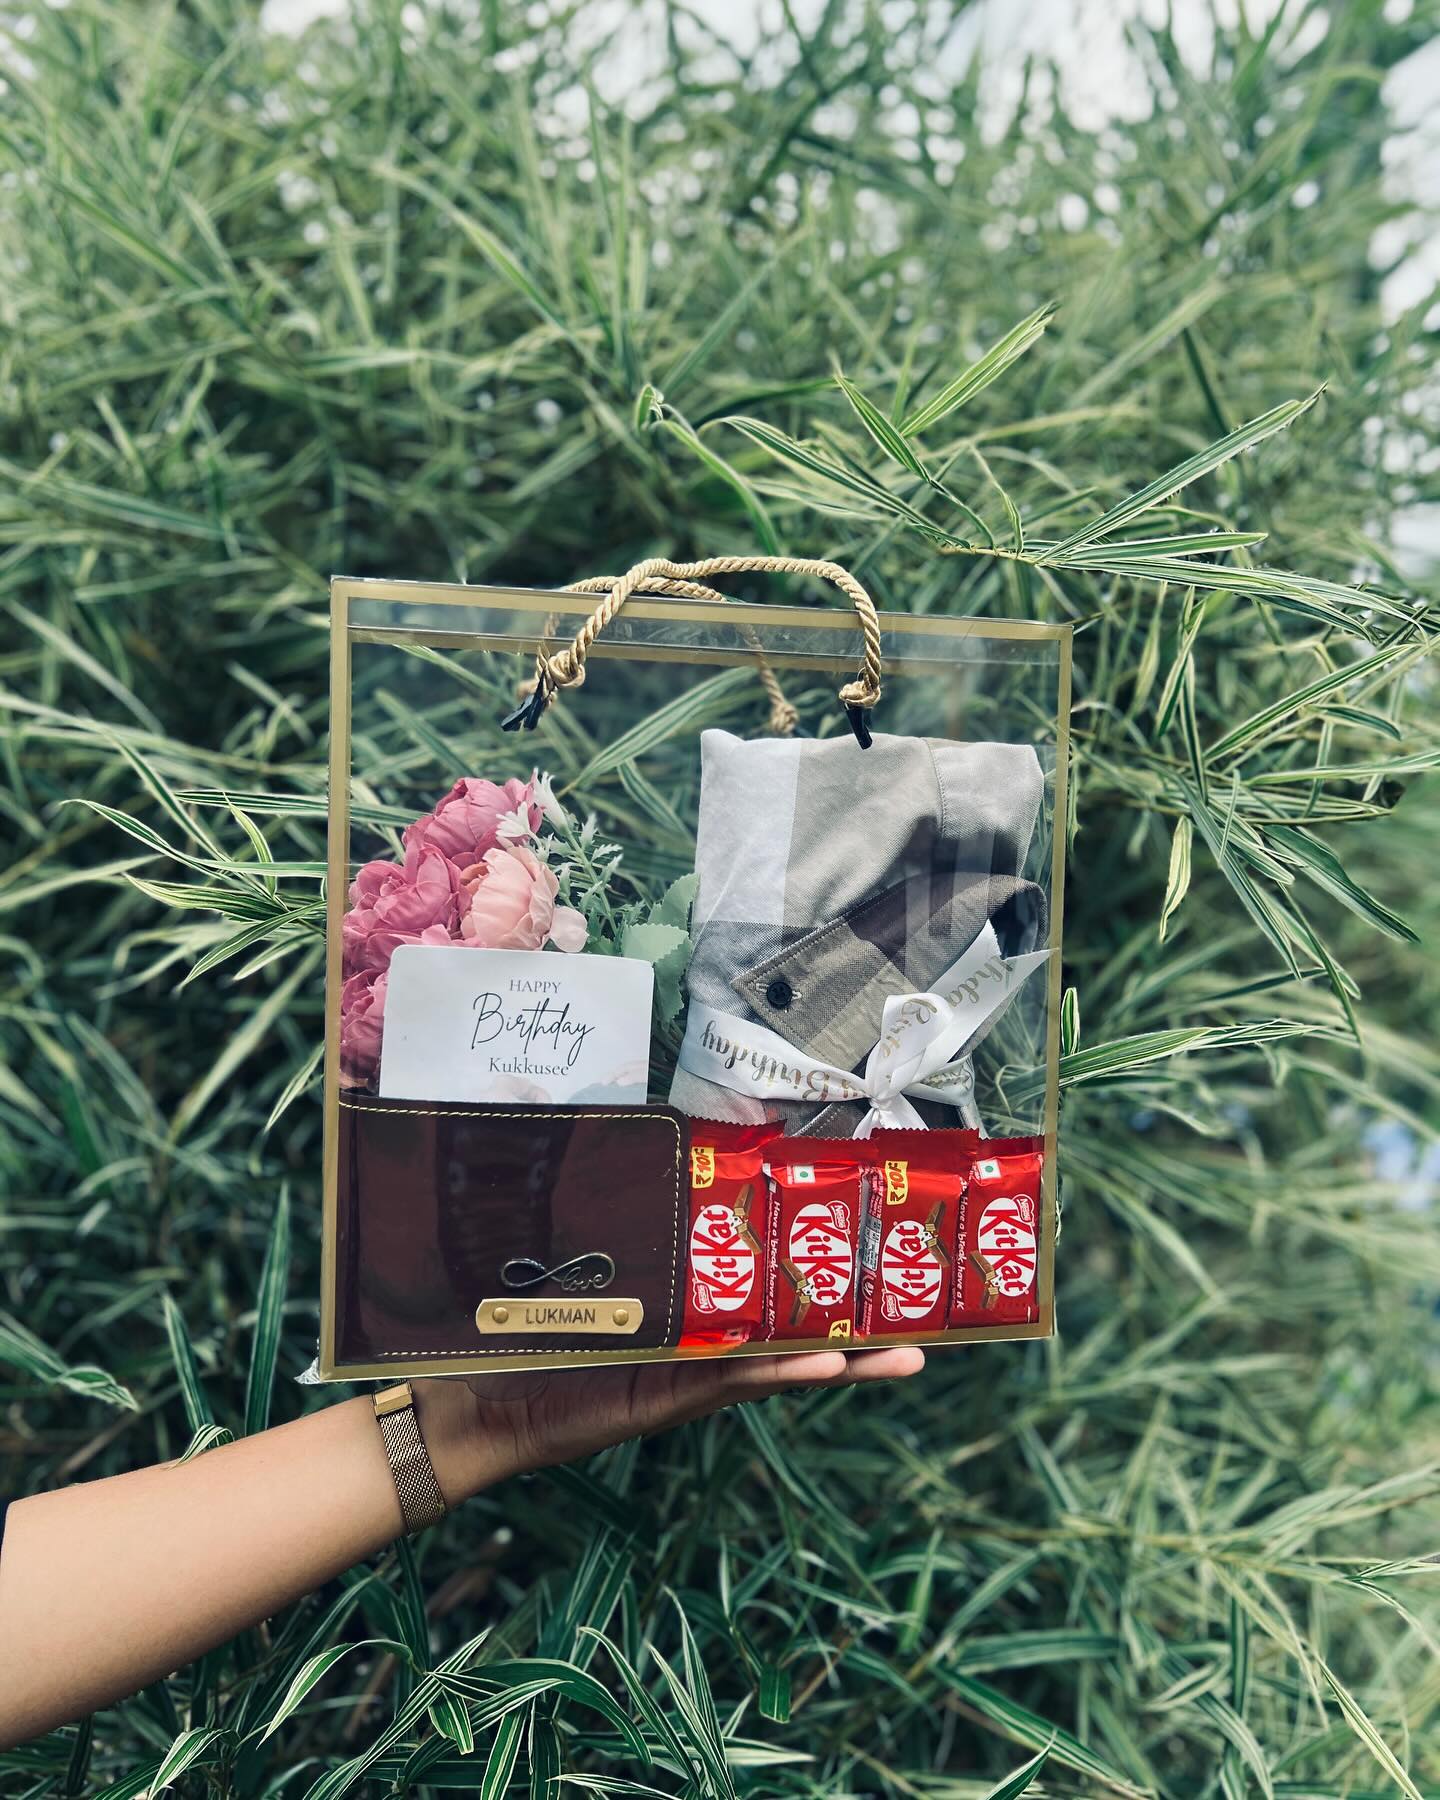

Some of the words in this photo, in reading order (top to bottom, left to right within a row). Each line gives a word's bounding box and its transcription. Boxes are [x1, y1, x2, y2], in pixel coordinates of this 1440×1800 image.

[510, 979, 561, 993] HAPPY
[471, 992, 596, 1067] Birthday
[700, 1019, 830, 1101] Birthday
[771, 1200, 781, 1227] Have
[960, 1196, 968, 1219] Have
[525, 1308, 597, 1325] LUKMAN
